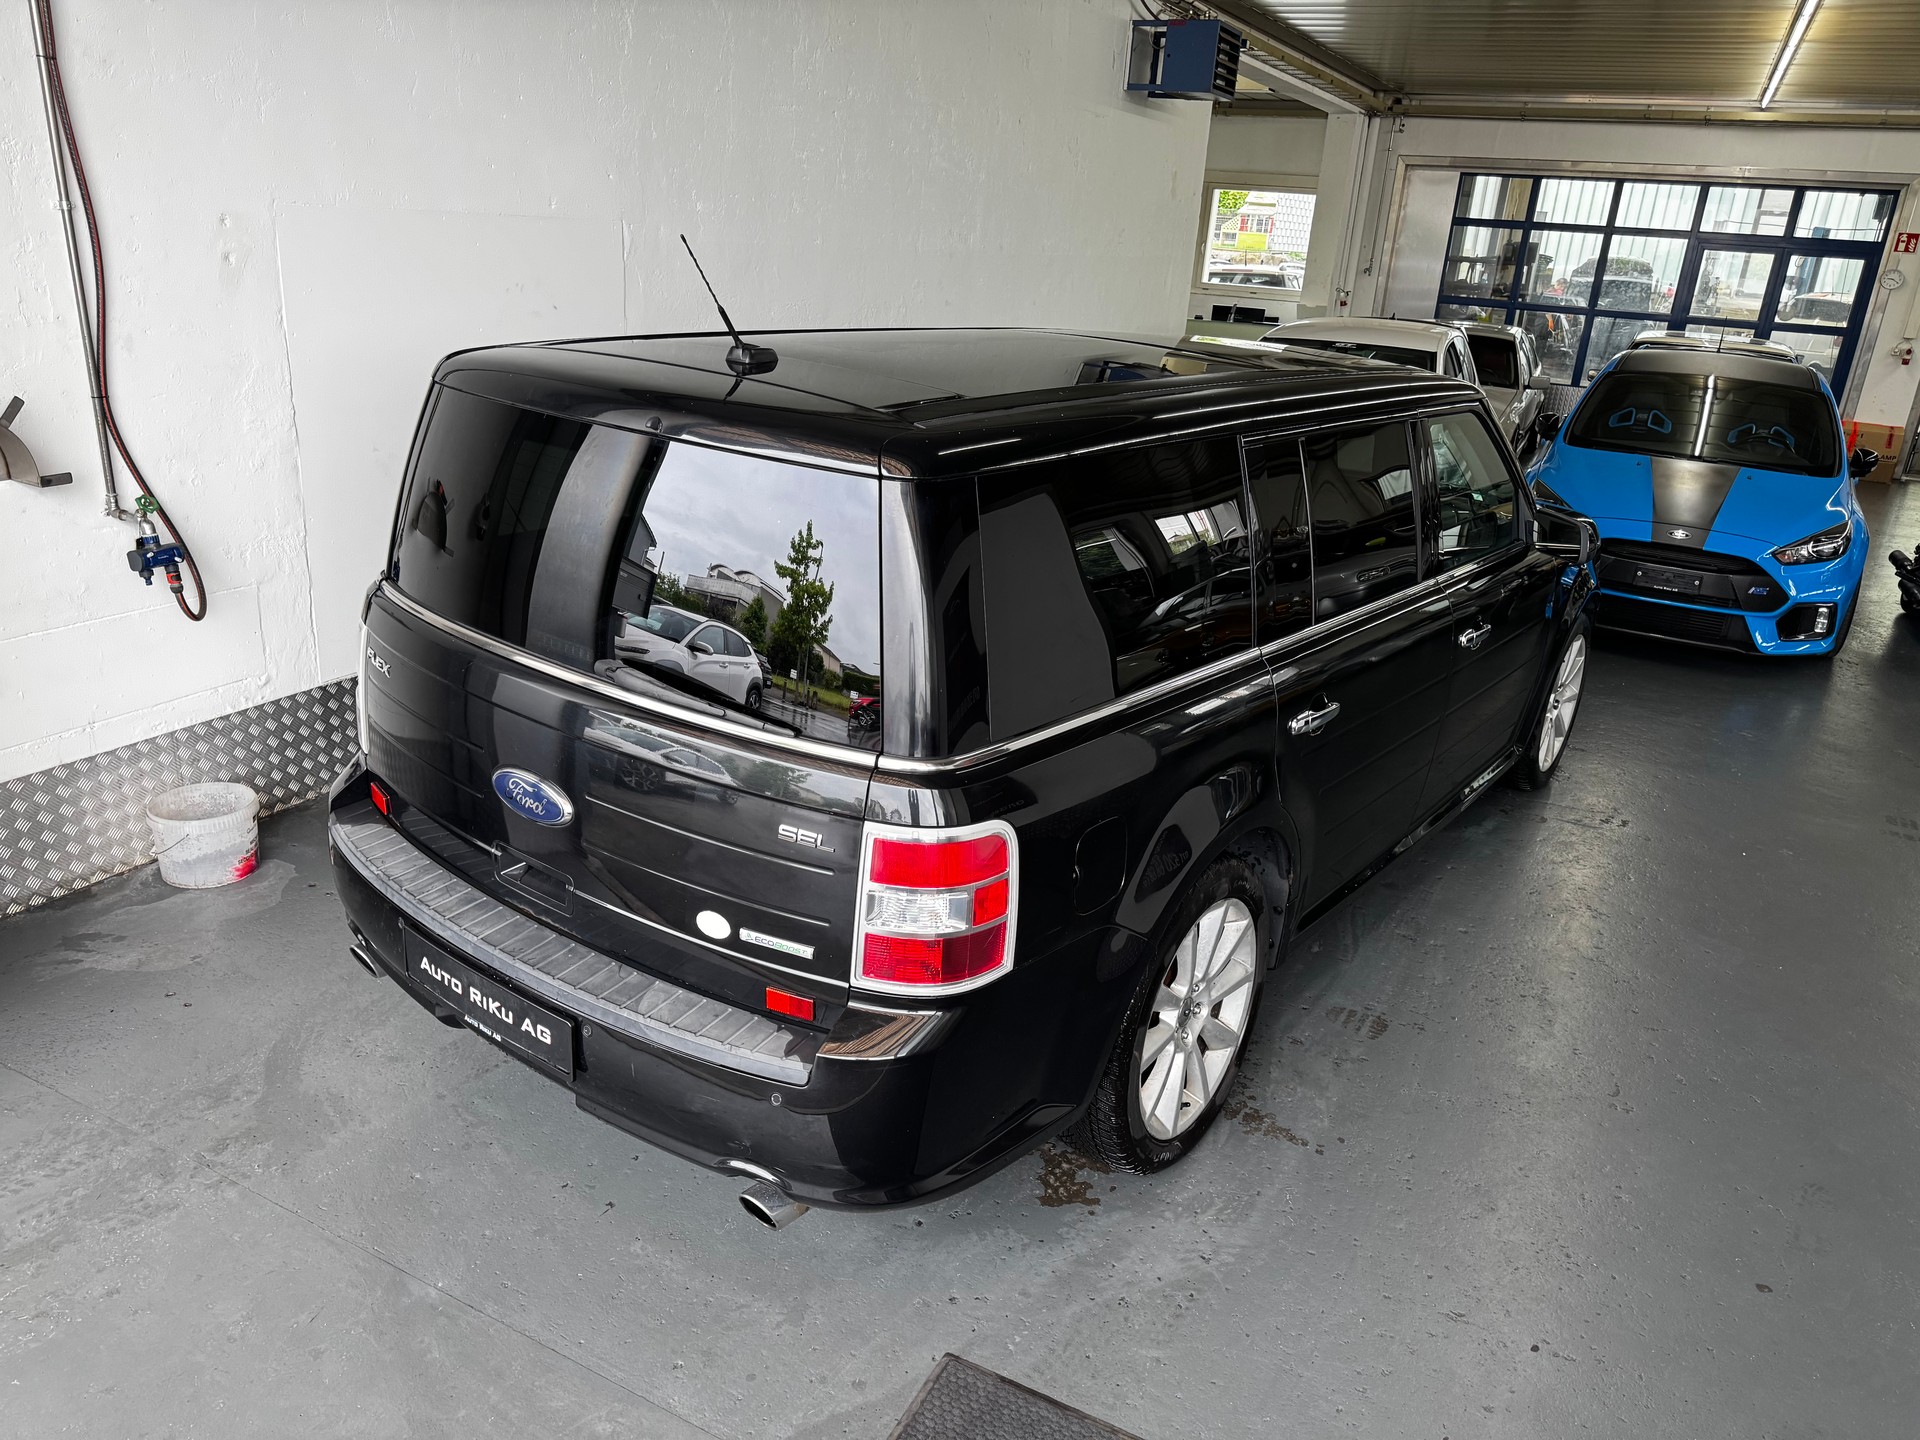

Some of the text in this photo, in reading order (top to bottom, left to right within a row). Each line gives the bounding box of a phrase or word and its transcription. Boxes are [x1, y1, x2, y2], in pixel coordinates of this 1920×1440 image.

[367, 646, 391, 678] FLEX
[507, 778, 548, 815] Ford
[778, 824, 835, 853] SEL
[420, 956, 463, 995] AUTO
[520, 1017, 552, 1045] AG
